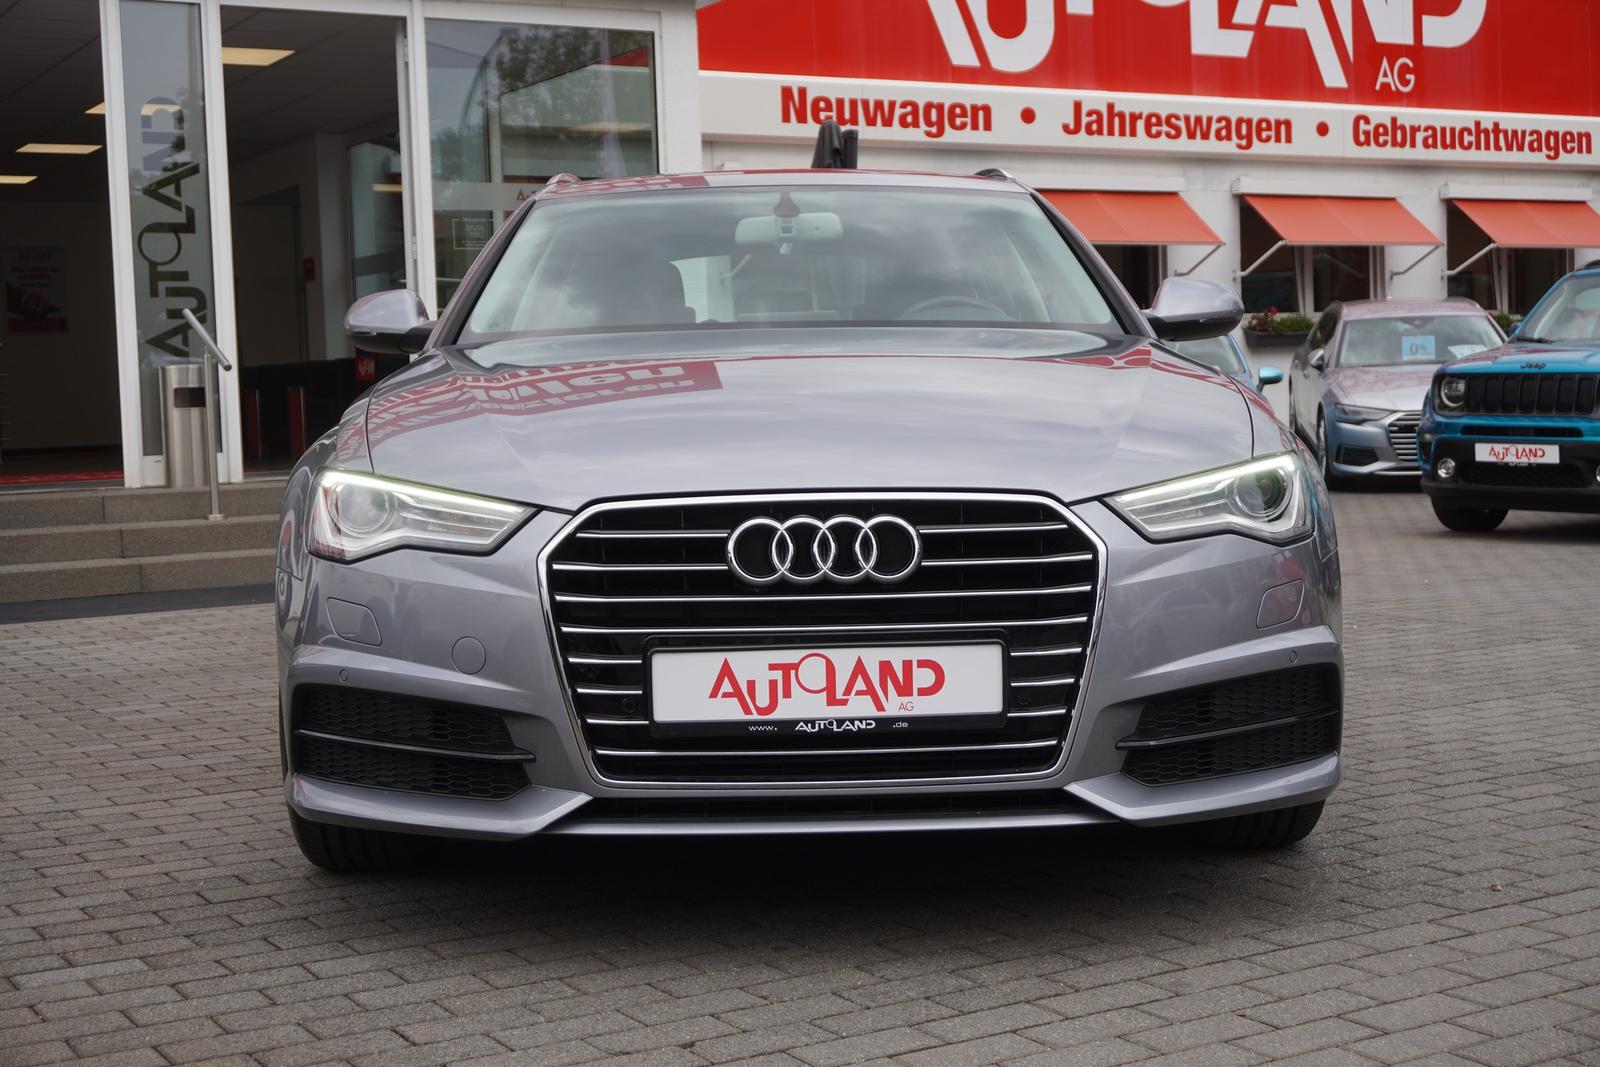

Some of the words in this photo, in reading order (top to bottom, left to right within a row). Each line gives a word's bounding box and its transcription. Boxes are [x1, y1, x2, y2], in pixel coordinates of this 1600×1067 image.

[1375, 56, 1416, 93] AG
[780, 85, 993, 139] Neuwagen
[1061, 99, 1293, 151] Jahreswagen
[1352, 113, 1593, 161] Gebrauchtwagen
[138, 96, 207, 358] AUTOLAND
[1520, 361, 1546, 370] Jeep
[1488, 444, 1546, 462] AUTOLAND
[708, 652, 946, 716] AUTOLAND
[898, 701, 914, 712] AG
[795, 719, 876, 732] AUTOLAND
